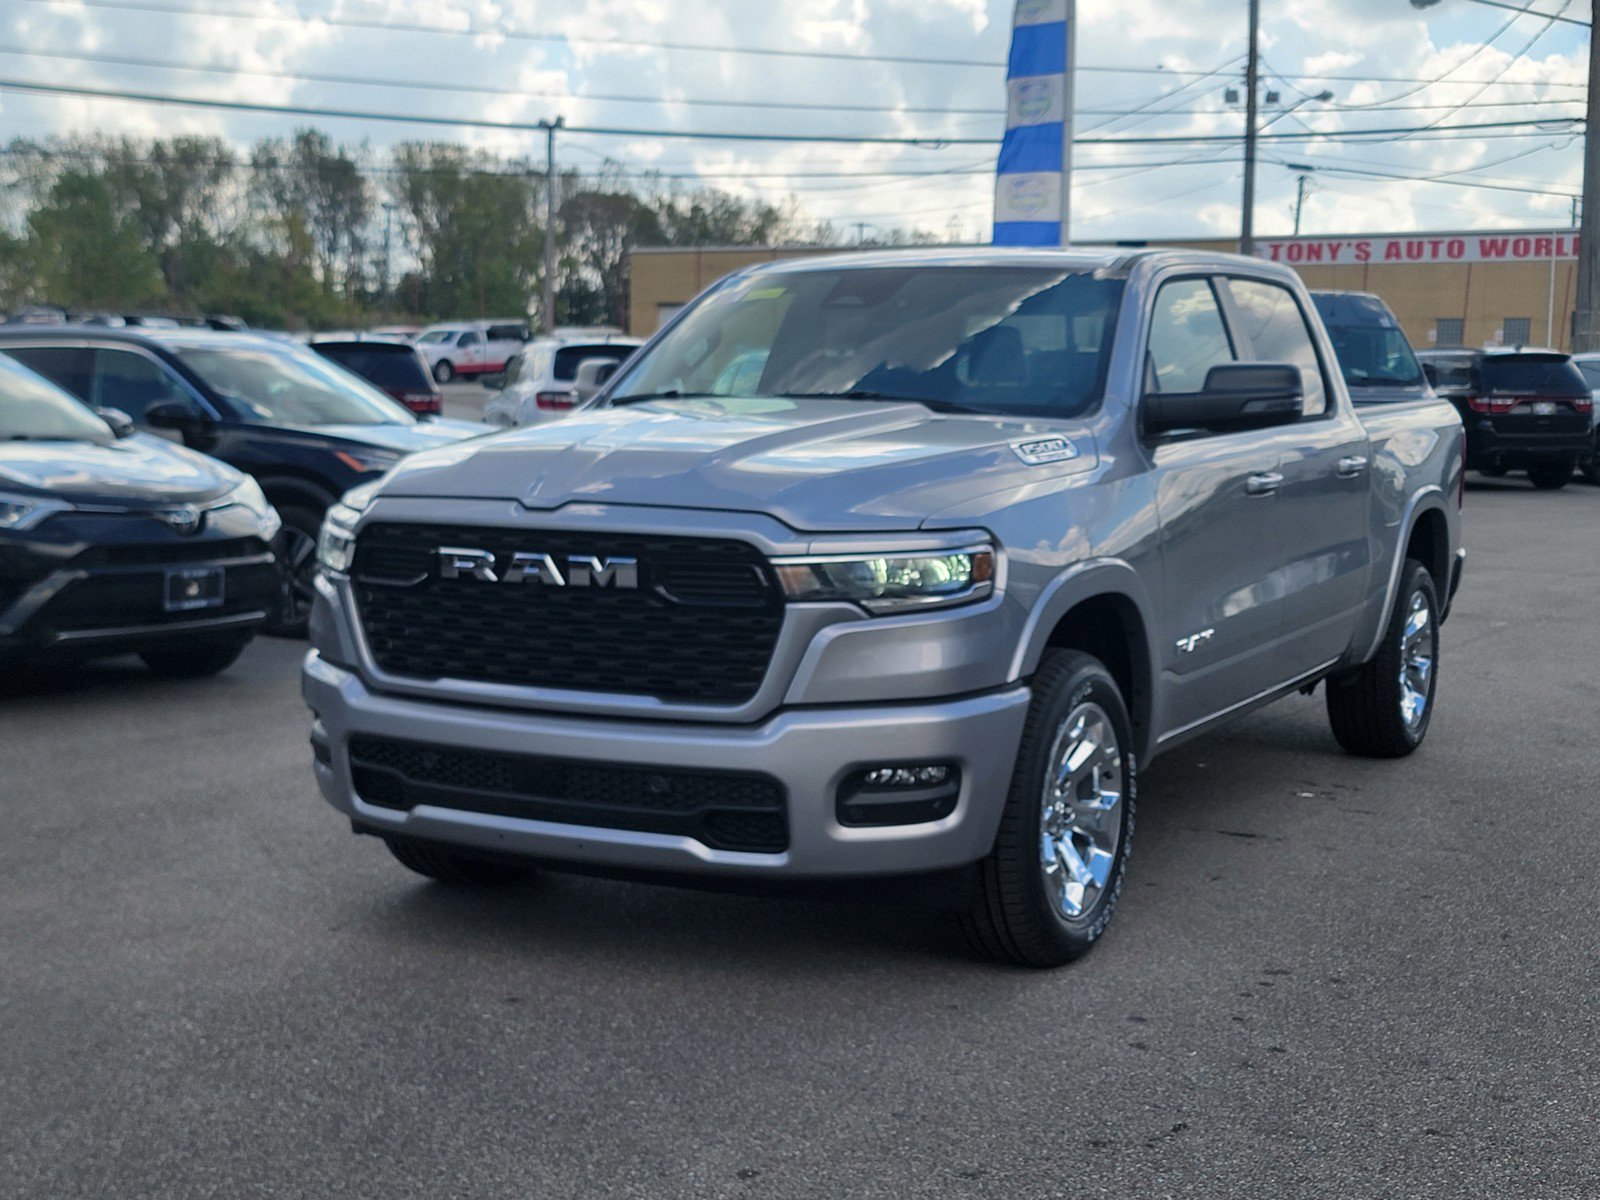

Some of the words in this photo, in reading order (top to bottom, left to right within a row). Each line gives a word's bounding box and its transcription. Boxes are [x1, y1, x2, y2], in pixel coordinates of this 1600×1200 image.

[1269, 240, 1372, 262] TONY'S
[1384, 238, 1465, 260] AUTO
[438, 546, 638, 589] RAM
